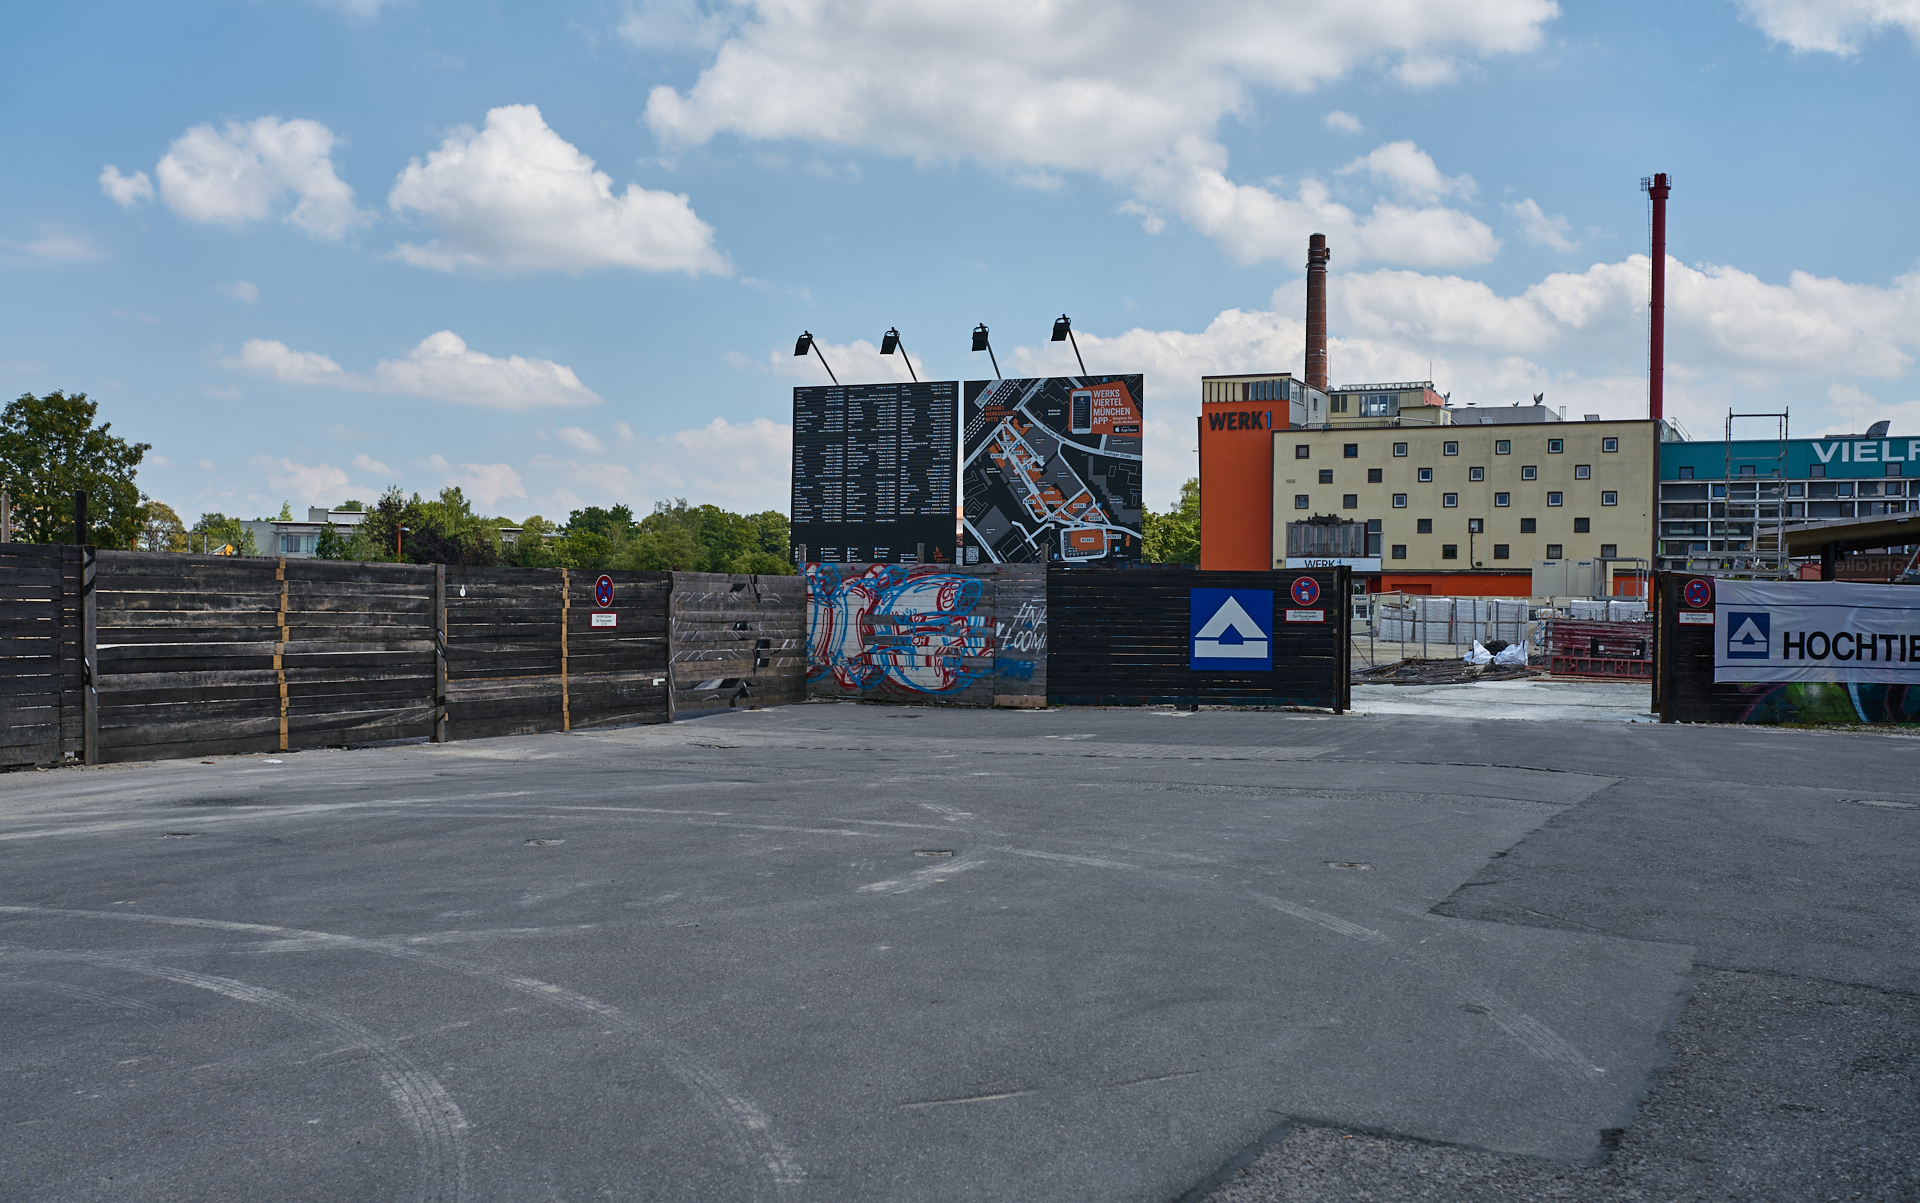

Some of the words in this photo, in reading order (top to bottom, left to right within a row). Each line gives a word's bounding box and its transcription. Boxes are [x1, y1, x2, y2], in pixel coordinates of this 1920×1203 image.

[1093, 390, 1120, 398] WERKS
[1093, 398, 1123, 406] VIERTEL
[1093, 407, 1130, 416] MÜNCHEN
